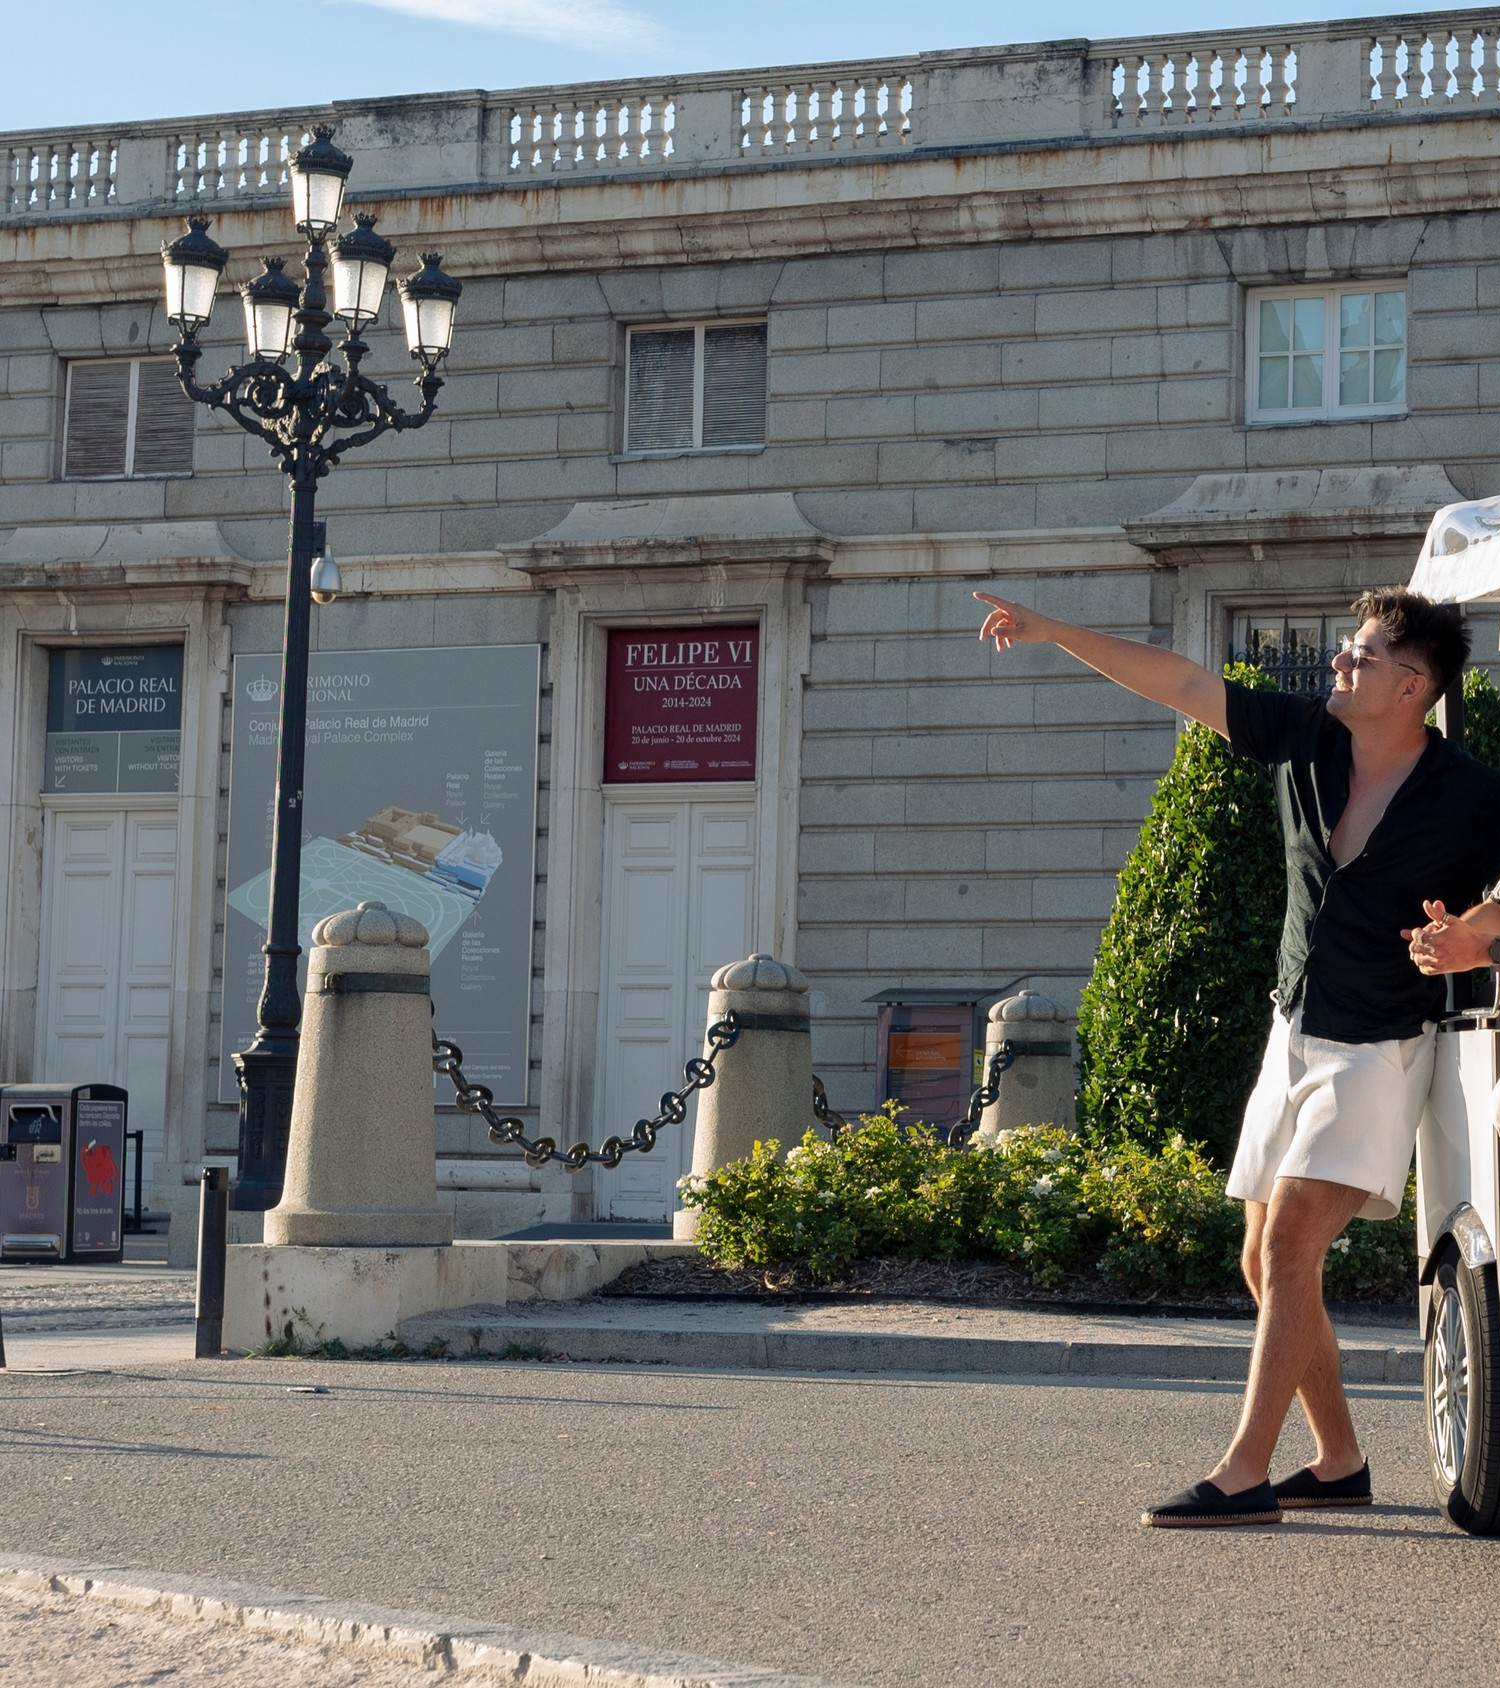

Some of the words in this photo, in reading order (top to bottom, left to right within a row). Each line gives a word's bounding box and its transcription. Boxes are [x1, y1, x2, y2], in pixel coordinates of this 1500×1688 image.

[625, 642, 720, 666] FELIPE
[727, 640, 753, 663] VI
[69, 678, 135, 695] PALACIO
[139, 677, 177, 693] REAL
[307, 674, 370, 688] RIMONIO
[634, 676, 670, 692] UNA
[674, 672, 742, 691] DÉCADA
[76, 699, 96, 714] DE
[100, 697, 166, 714] MADRID
[662, 696, 712, 708] 2014-2024
[249, 719, 280, 733] Conju
[345, 717, 369, 730] Real
[372, 717, 387, 729] de
[390, 715, 429, 728] Madrid
[631, 725, 668, 734] PALACIO
[669, 724, 691, 733] REAL
[692, 724, 704, 733] DE
[705, 723, 742, 733] MADRID
[56, 738, 91, 746] VISITANTES
[248, 734, 278, 746] Madr
[304, 732, 320, 746] yal
[324, 732, 361, 744] Palace
[364, 731, 414, 745] Complex
[631, 736, 640, 744] 20
[641, 735, 650, 744] de
[650, 735, 669, 746] junio
[675, 735, 685, 744] 20
[685, 734, 695, 743] de
[695, 734, 722, 743] octubre
[723, 734, 741, 743] 2024
[144, 744, 156, 752] SIN
[55, 756, 84, 764] VISITORS
[55, 764, 71, 772] WITH
[73, 764, 99, 772] TICKETS
[128, 763, 158, 771] WITHOUT
[446, 772, 469, 780] Palacio
[484, 772, 506, 780] Reales
[446, 781, 460, 789] Real
[288, 798, 296, 808] 2
